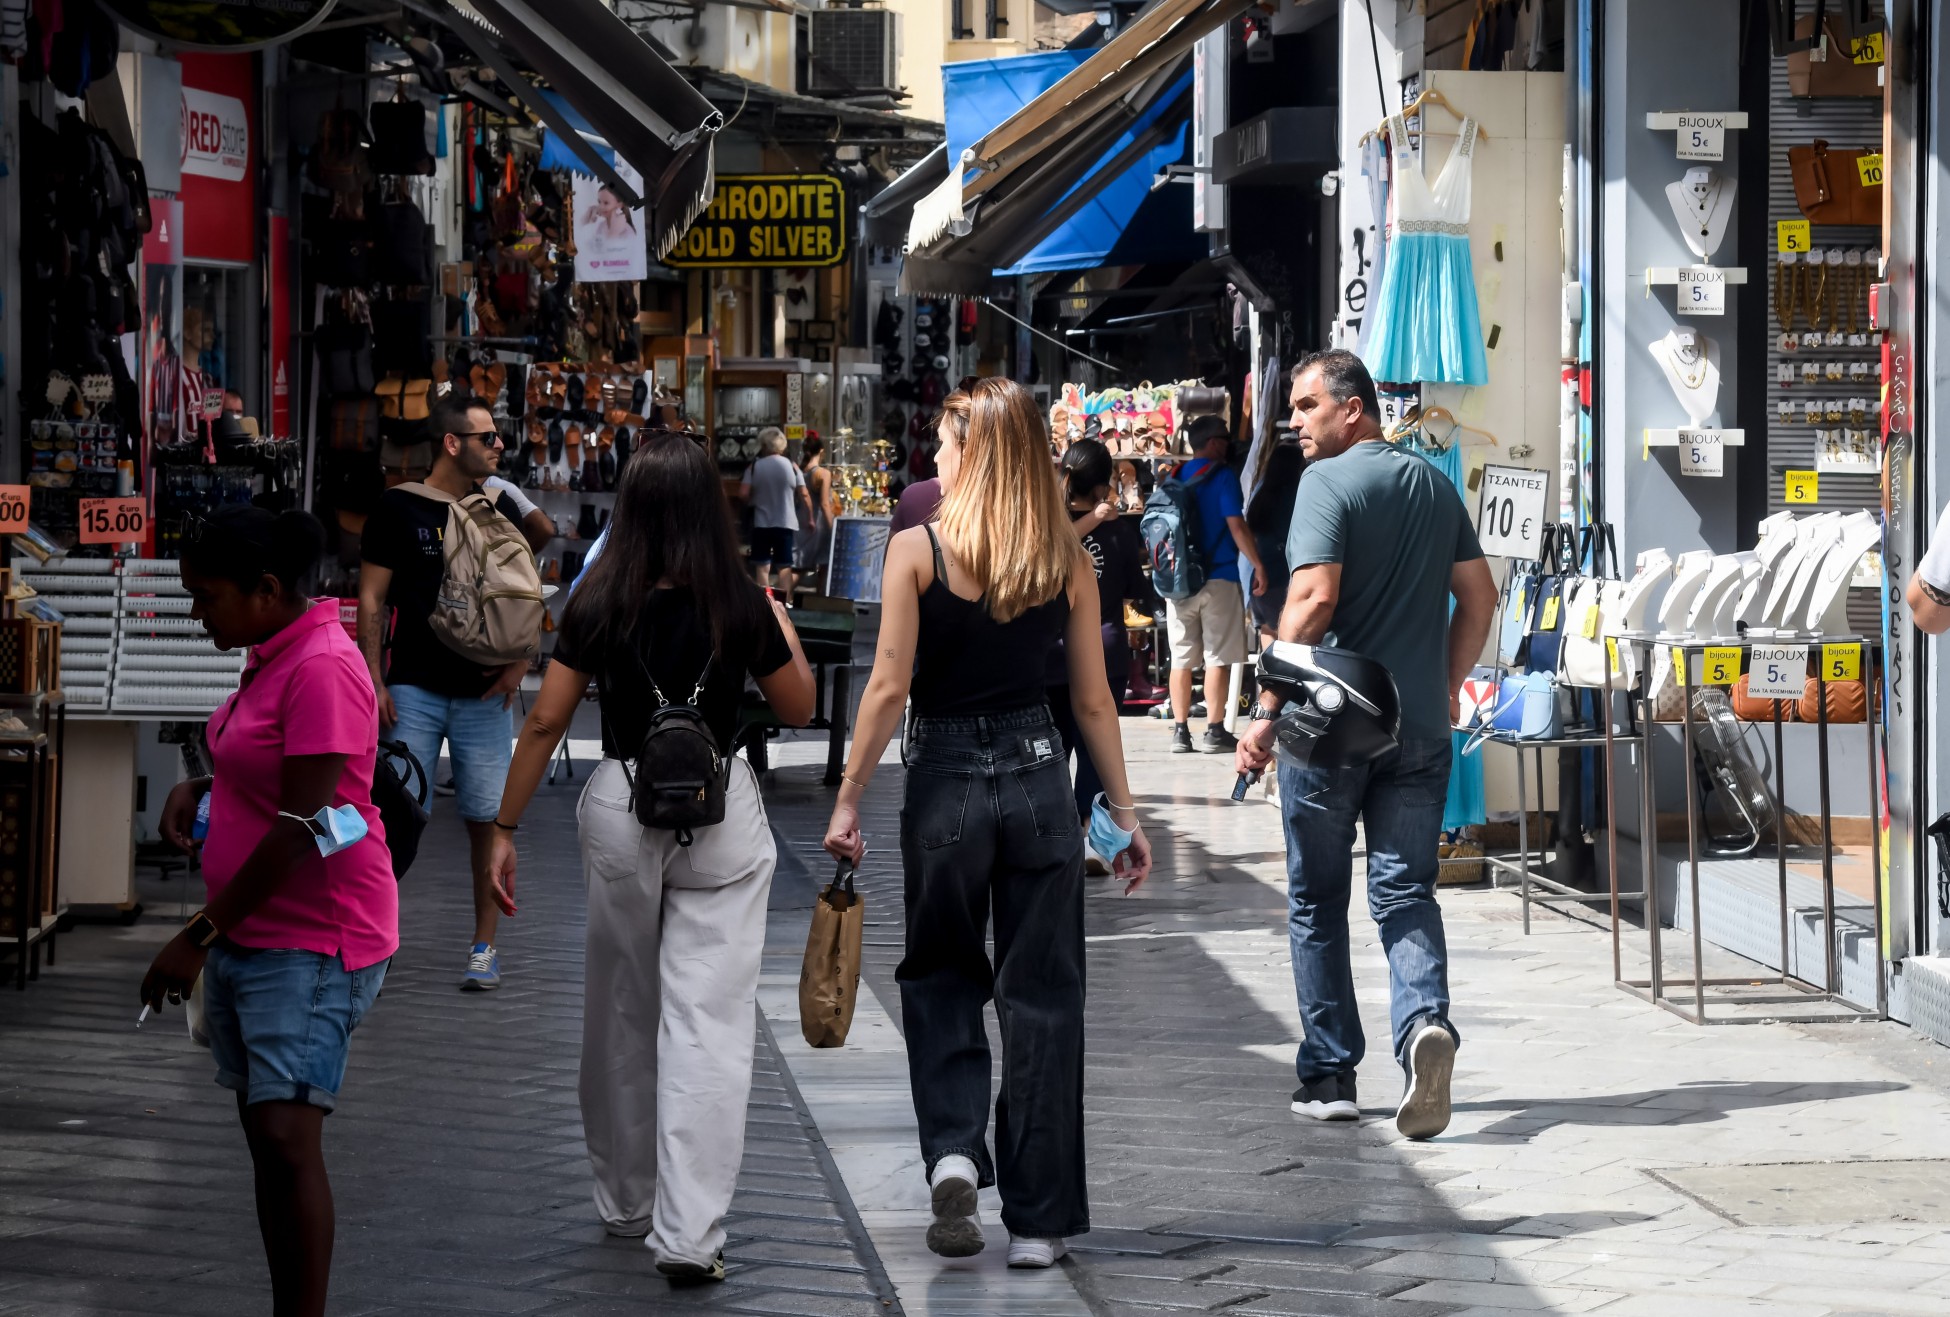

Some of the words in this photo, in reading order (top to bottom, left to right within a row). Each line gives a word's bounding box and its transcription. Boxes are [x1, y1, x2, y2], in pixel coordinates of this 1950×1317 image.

[1679, 117, 1723, 129] BIJOUX
[189, 110, 221, 154] RED
[222, 117, 245, 154] store
[707, 185, 834, 220] HRODITE
[1782, 223, 1805, 232] bijoux
[749, 226, 833, 257] SILVER
[1679, 272, 1723, 282] BIJOUX
[1679, 434, 1721, 444] BIJOUX
[1488, 474, 1542, 490] ΤΣΑΝΤΕΣ
[83, 508, 142, 533] 15.00
[1487, 496, 1514, 538] 10
[1709, 651, 1736, 661] bijoux
[1752, 649, 1806, 661] BIJOUX
[1828, 647, 1855, 657] bijoux
